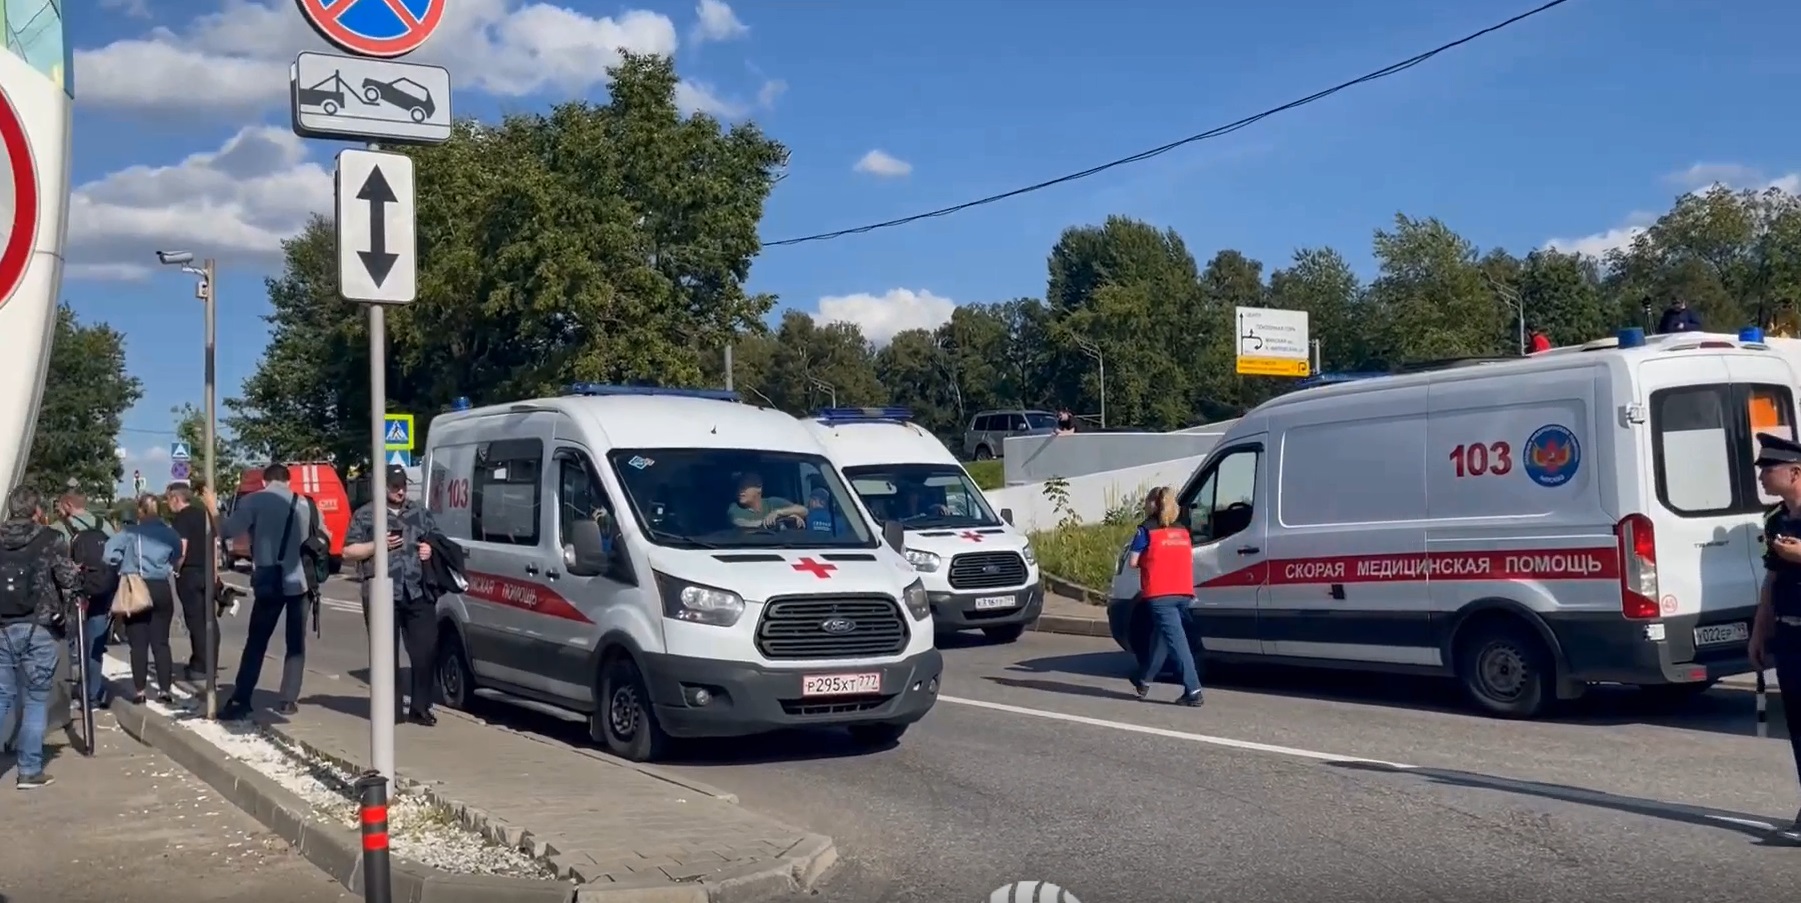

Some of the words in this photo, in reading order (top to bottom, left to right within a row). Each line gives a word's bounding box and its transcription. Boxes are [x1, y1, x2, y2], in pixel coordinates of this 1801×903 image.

[1449, 441, 1512, 477] 103
[447, 478, 469, 508] 103
[1285, 562, 1345, 579] СКОРАЯ
[1356, 557, 1491, 579] МЕДИЦИНСКАЯ
[1505, 554, 1602, 576] ПОМОЩЬ
[501, 583, 537, 608] ПОМОЩЬ
[859, 675, 877, 687] 777
